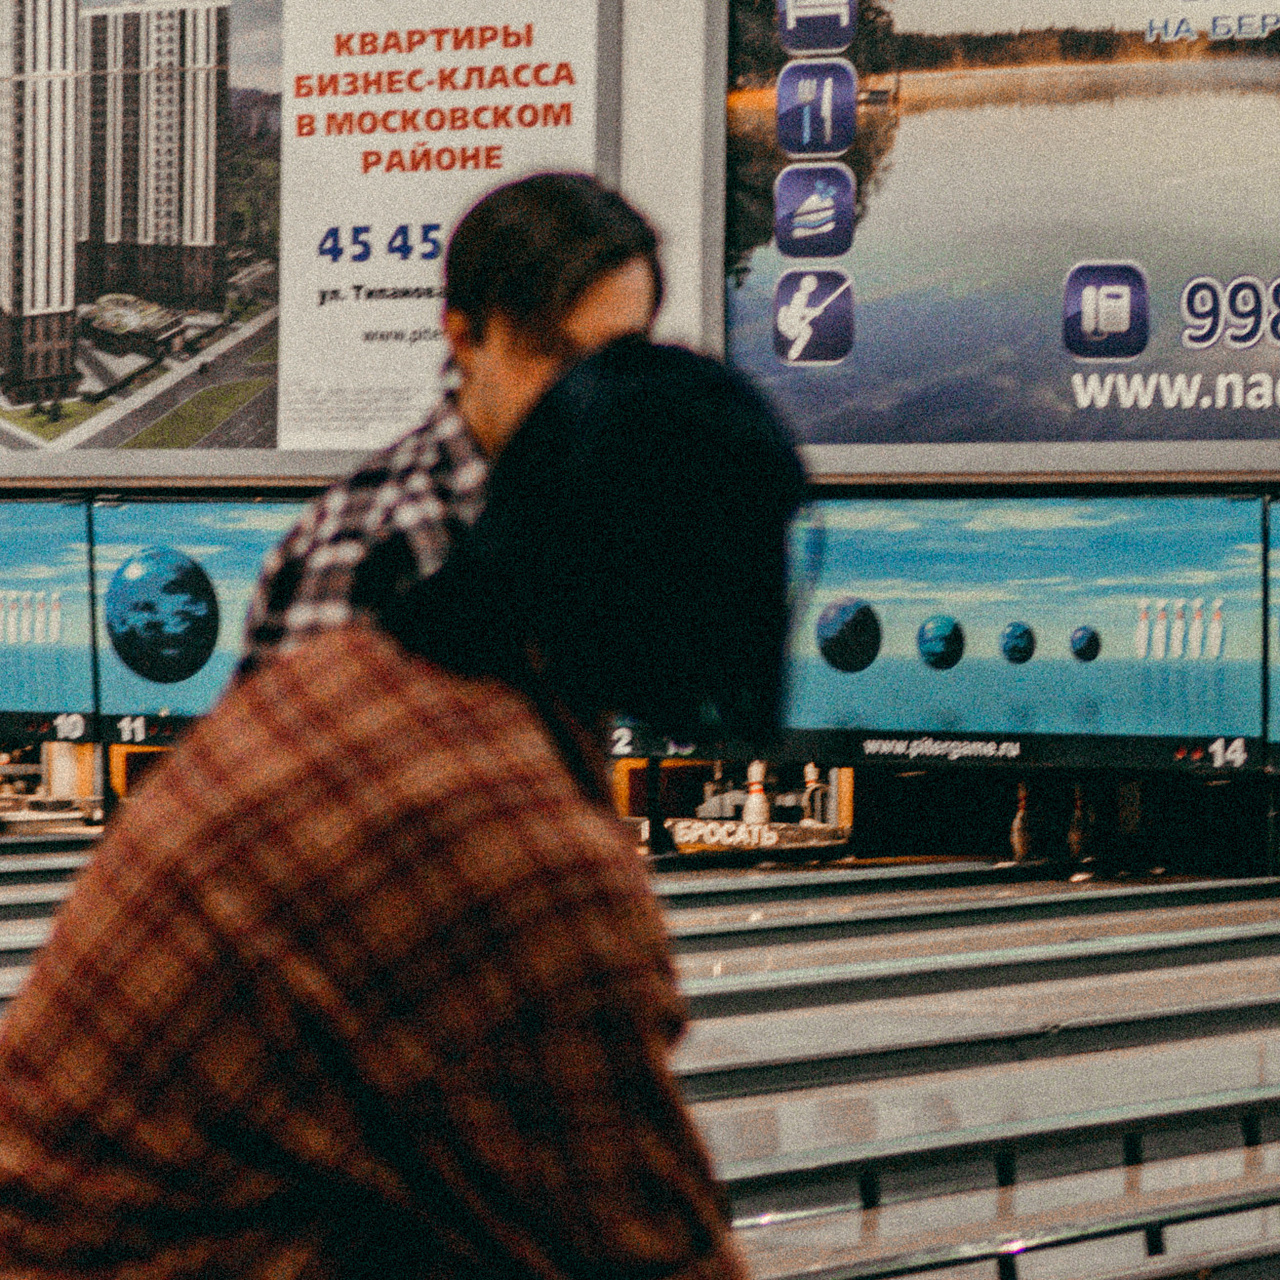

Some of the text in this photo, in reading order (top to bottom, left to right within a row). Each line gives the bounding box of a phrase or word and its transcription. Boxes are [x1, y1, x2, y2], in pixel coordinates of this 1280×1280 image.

[334, 22, 535, 58] КВАРТИРЫ
[1145, 17, 1199, 43] НА
[294, 61, 576, 100] БИЗНЕС-КЛАССА
[296, 102, 574, 138] В МОСКОВСКОМ
[361, 141, 504, 175] РАЙОНЕ
[318, 223, 441, 263] 45 45
[53, 713, 85, 742] 10
[117, 715, 146, 743] 11
[863, 736, 1021, 761] www.pitergame.ru
[1208, 736, 1248, 769] 14
[673, 821, 780, 847] БРОСАТЬ
